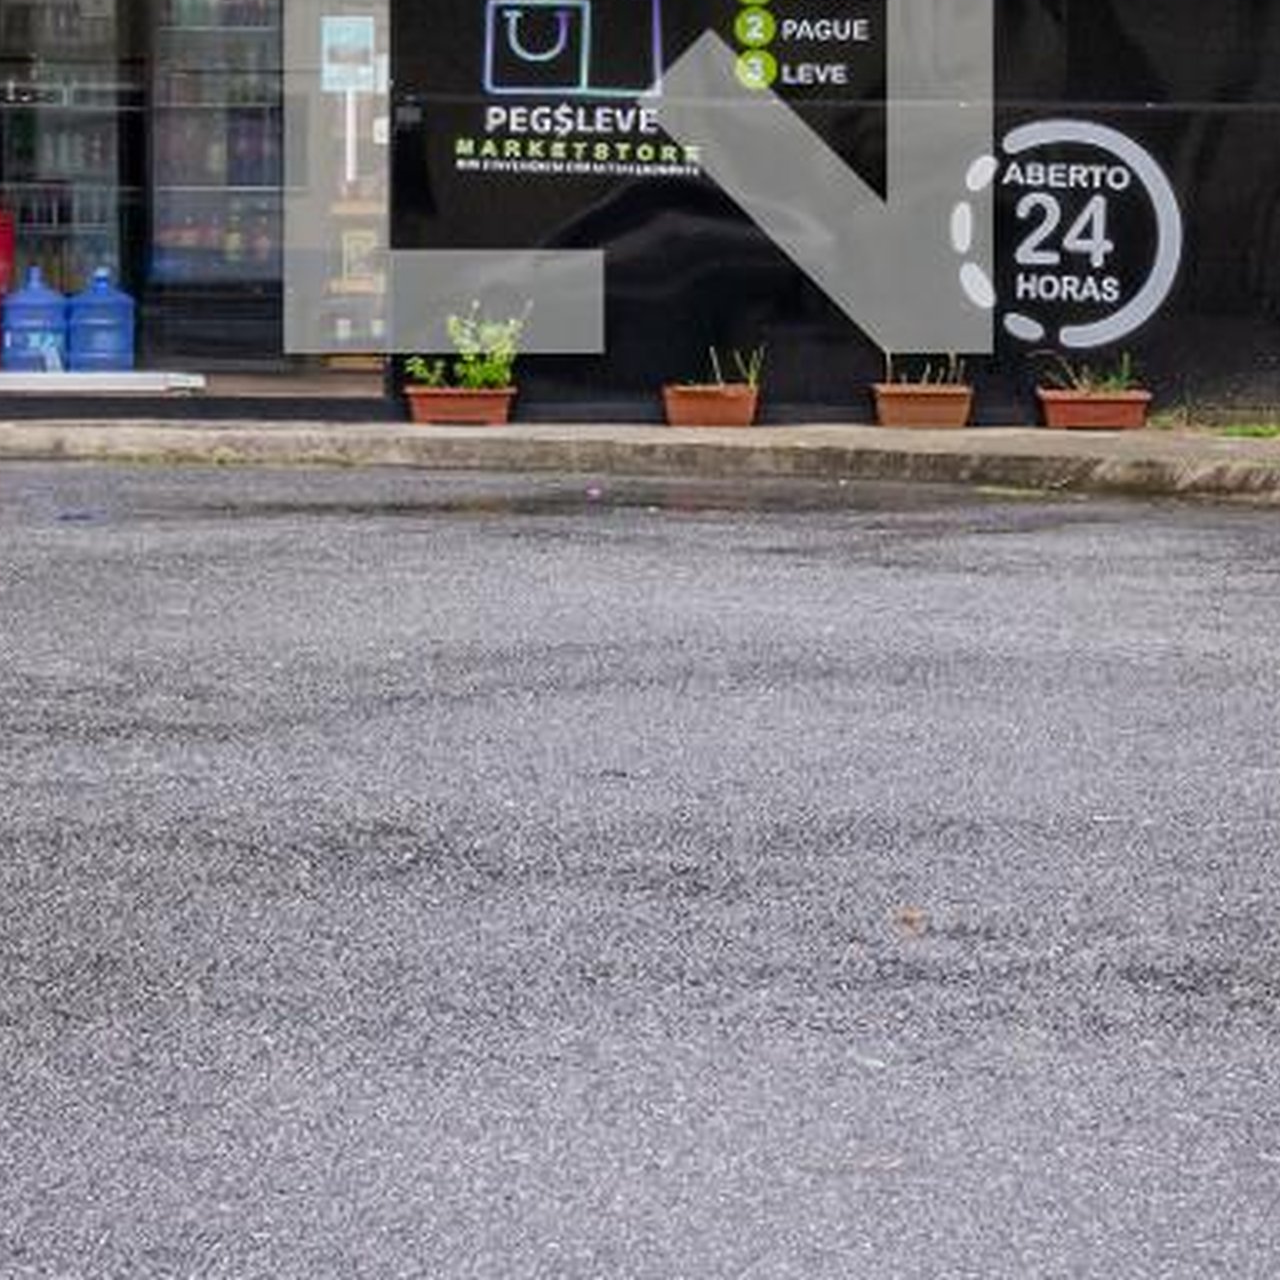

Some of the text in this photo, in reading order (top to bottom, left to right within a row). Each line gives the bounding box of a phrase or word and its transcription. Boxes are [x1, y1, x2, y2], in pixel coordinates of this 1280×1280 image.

[745, 15, 870, 41] 2 PAGUE
[745, 57, 849, 85] 3 LEVE
[1002, 161, 1131, 191] ABERTO
[1014, 191, 1114, 268] 24
[1015, 272, 1120, 303] HORAS
